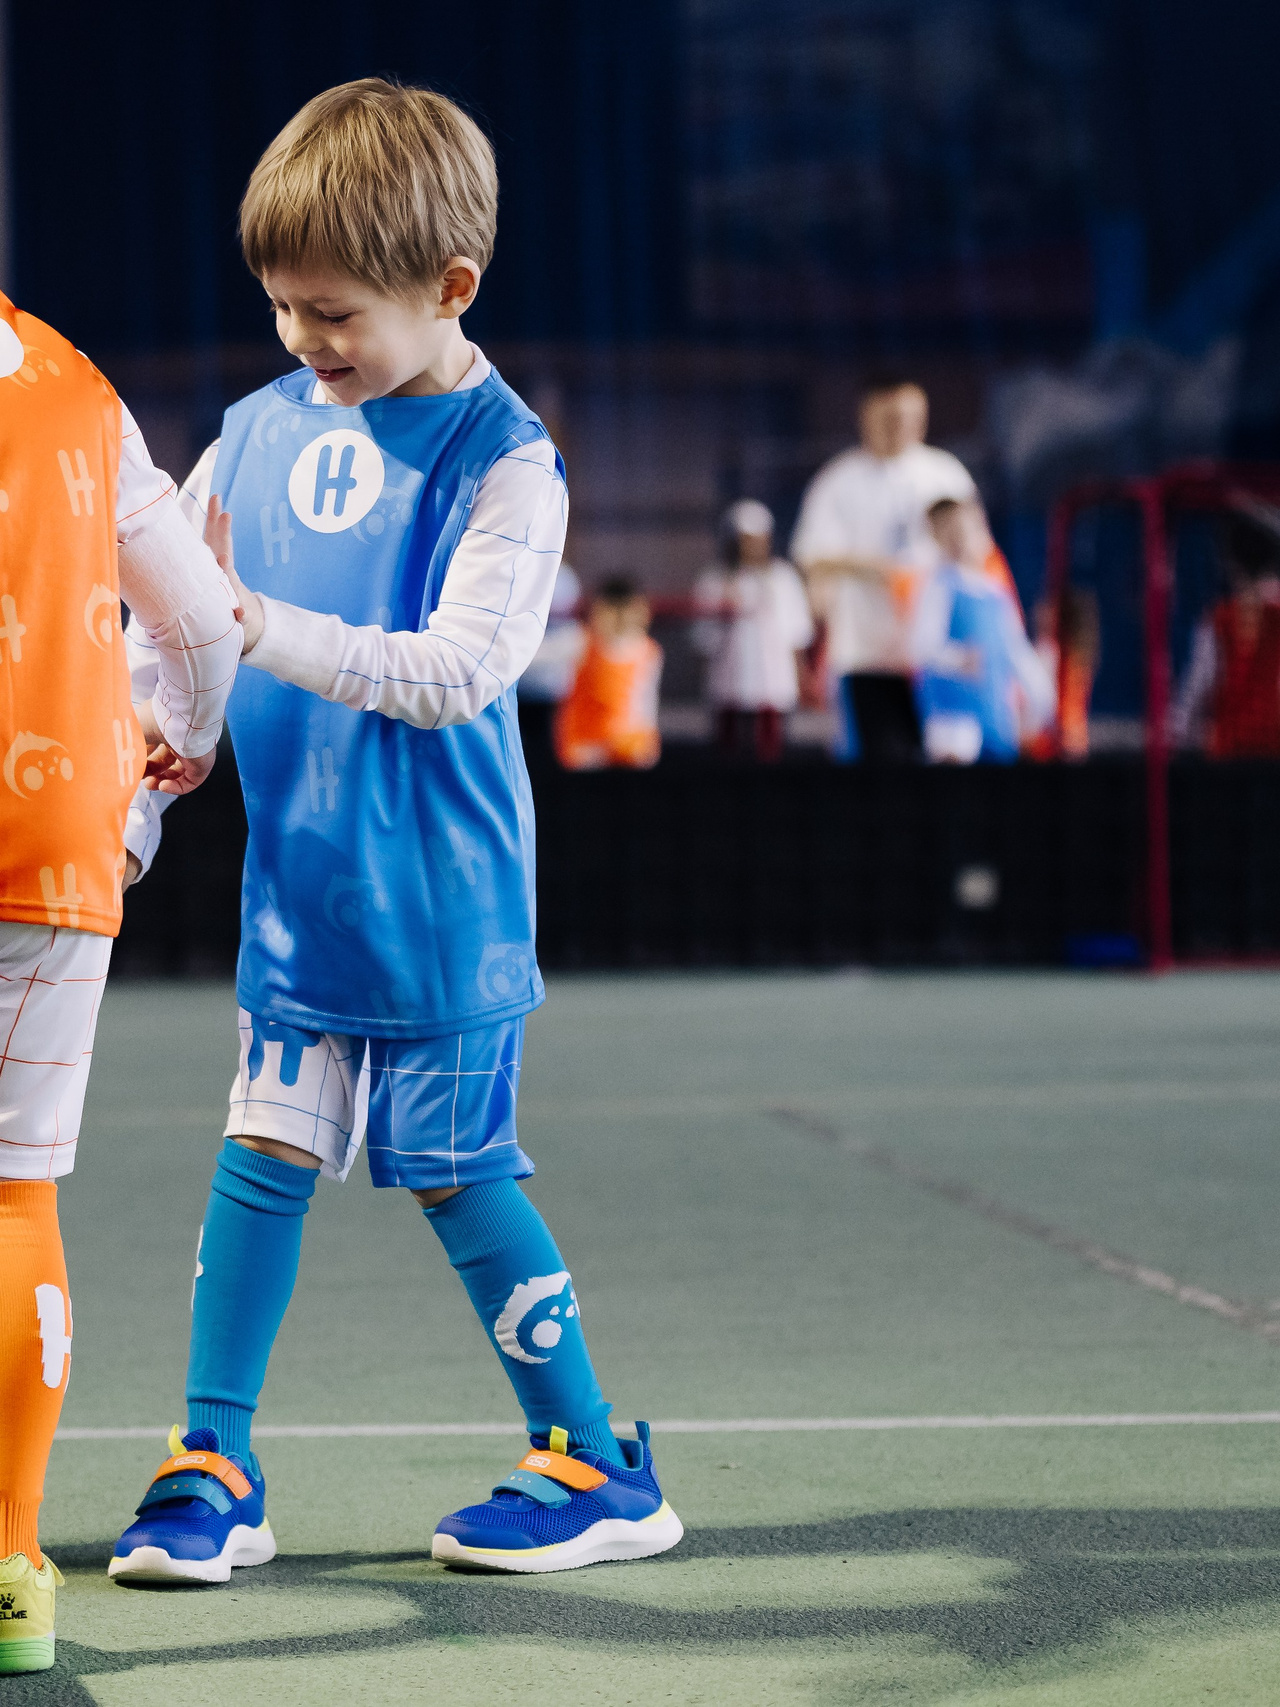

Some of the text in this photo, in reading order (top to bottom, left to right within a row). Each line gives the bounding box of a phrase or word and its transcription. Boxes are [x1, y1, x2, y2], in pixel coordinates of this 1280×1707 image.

[57, 448, 96, 517] H
[313, 444, 358, 517] H
[259, 501, 296, 568] H
[113, 718, 137, 787] H
[307, 747, 339, 814] H
[427, 826, 477, 894] H
[39, 863, 84, 928] H
